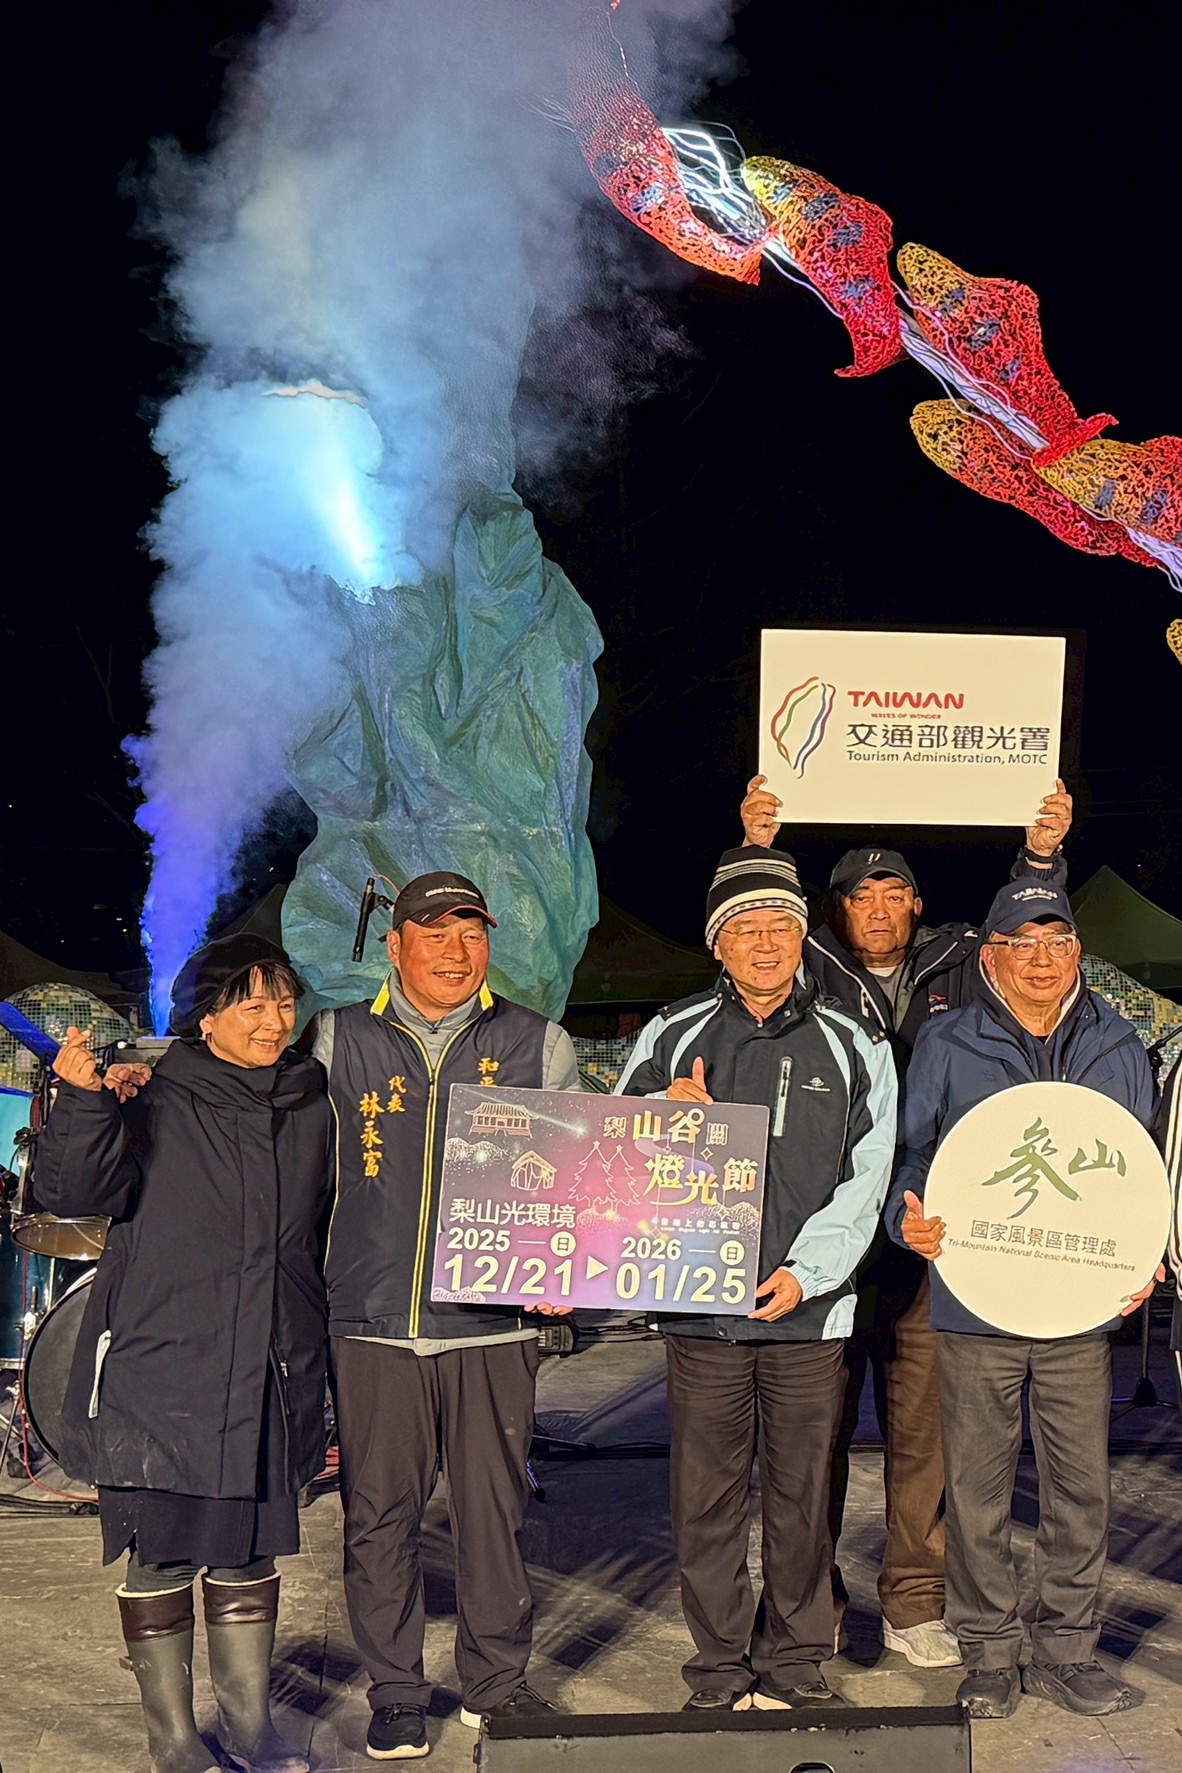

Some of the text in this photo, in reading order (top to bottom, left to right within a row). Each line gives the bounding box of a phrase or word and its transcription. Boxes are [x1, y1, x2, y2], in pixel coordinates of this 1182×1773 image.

[848, 691, 965, 709] TAIWAN
[846, 723, 1051, 751] 交通部觀光署
[847, 751, 1048, 765] Tourism Administration, MOTC
[386, 1075, 407, 1114] 代表
[359, 1091, 385, 1178] 林永富
[643, 1153, 758, 1206] 燈光節
[449, 1198, 576, 1229] 梨山光環境
[447, 1227, 511, 1252] 2025
[621, 1236, 682, 1261] 2026
[970, 1220, 1117, 1257] 國家風景區管理處
[444, 1253, 573, 1298] 12/21
[615, 1262, 746, 1304] 01/25
